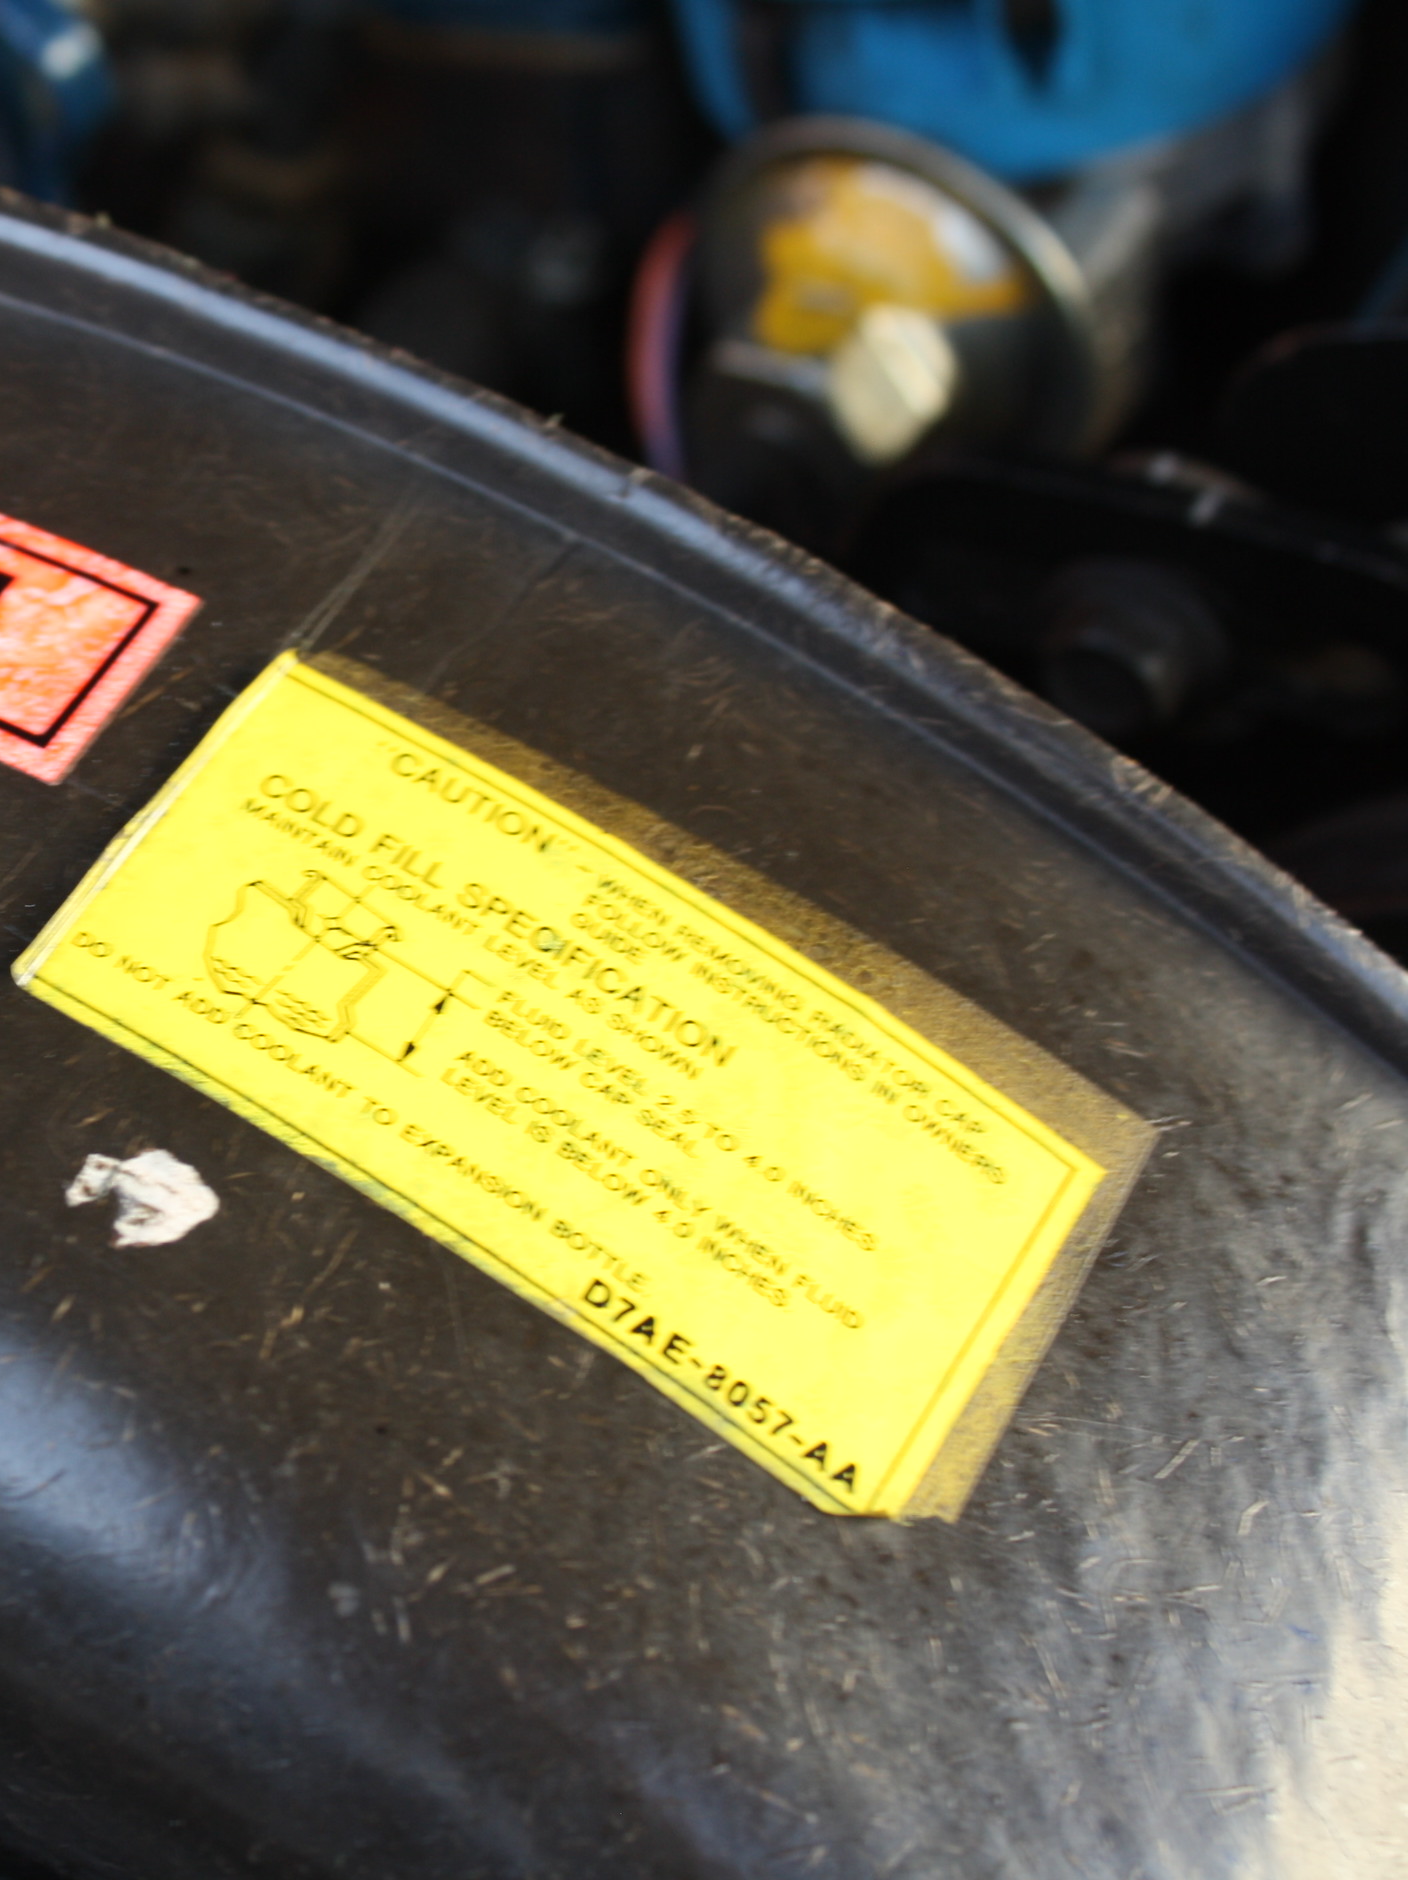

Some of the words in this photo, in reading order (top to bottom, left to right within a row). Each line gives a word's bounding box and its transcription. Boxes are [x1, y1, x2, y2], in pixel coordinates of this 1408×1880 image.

[241, 798, 358, 867] MAINTAIN
[362, 865, 482, 935] COOLANT
[482, 935, 560, 990] LEVEL
[564, 988, 604, 1015] AS
[606, 1012, 703, 1080] SHOWN
[260, 774, 365, 838] COLD
[369, 833, 443, 889] FILL
[456, 882, 738, 1068] SPECIFICATION
[570, 912, 646, 964] GUIDE
[583, 893, 687, 962] FOLLOW
[689, 961, 866, 1081] INSTRUCTIONS
[870, 1079, 900, 1105] IN
[596, 873, 672, 926] WHEN
[674, 924, 802, 1011] REMOVING
[809, 1010, 930, 1097] RADIATOR
[934, 1099, 988, 1134] CAP
[70, 931, 115, 957] DO
[113, 955, 172, 990] NOT
[172, 991, 231, 1024] ADD
[232, 1023, 357, 1098] COOLANT
[360, 1096, 399, 1126] TO
[399, 1122, 548, 1222] EXPANSION
[440, 1067, 518, 1125] LEVEL
[525, 1119, 553, 1144] IS
[555, 1140, 651, 1206] BELOW
[484, 1009, 579, 1071] BELOW
[579, 1071, 633, 1105] CAP
[497, 989, 571, 1040] FLUID
[572, 1038, 649, 1096] LEVEL
[703, 1122, 741, 1153] TO
[788, 1180, 879, 1252] INCHES
[453, 1050, 513, 1087] ADD
[514, 1086, 638, 1165] COOLANT
[639, 1168, 712, 1217] ONLY
[713, 1215, 791, 1276] WHEN
[792, 1273, 864, 1330] FLUID
[581, 1278, 859, 1493] D7AE-8057-AA
